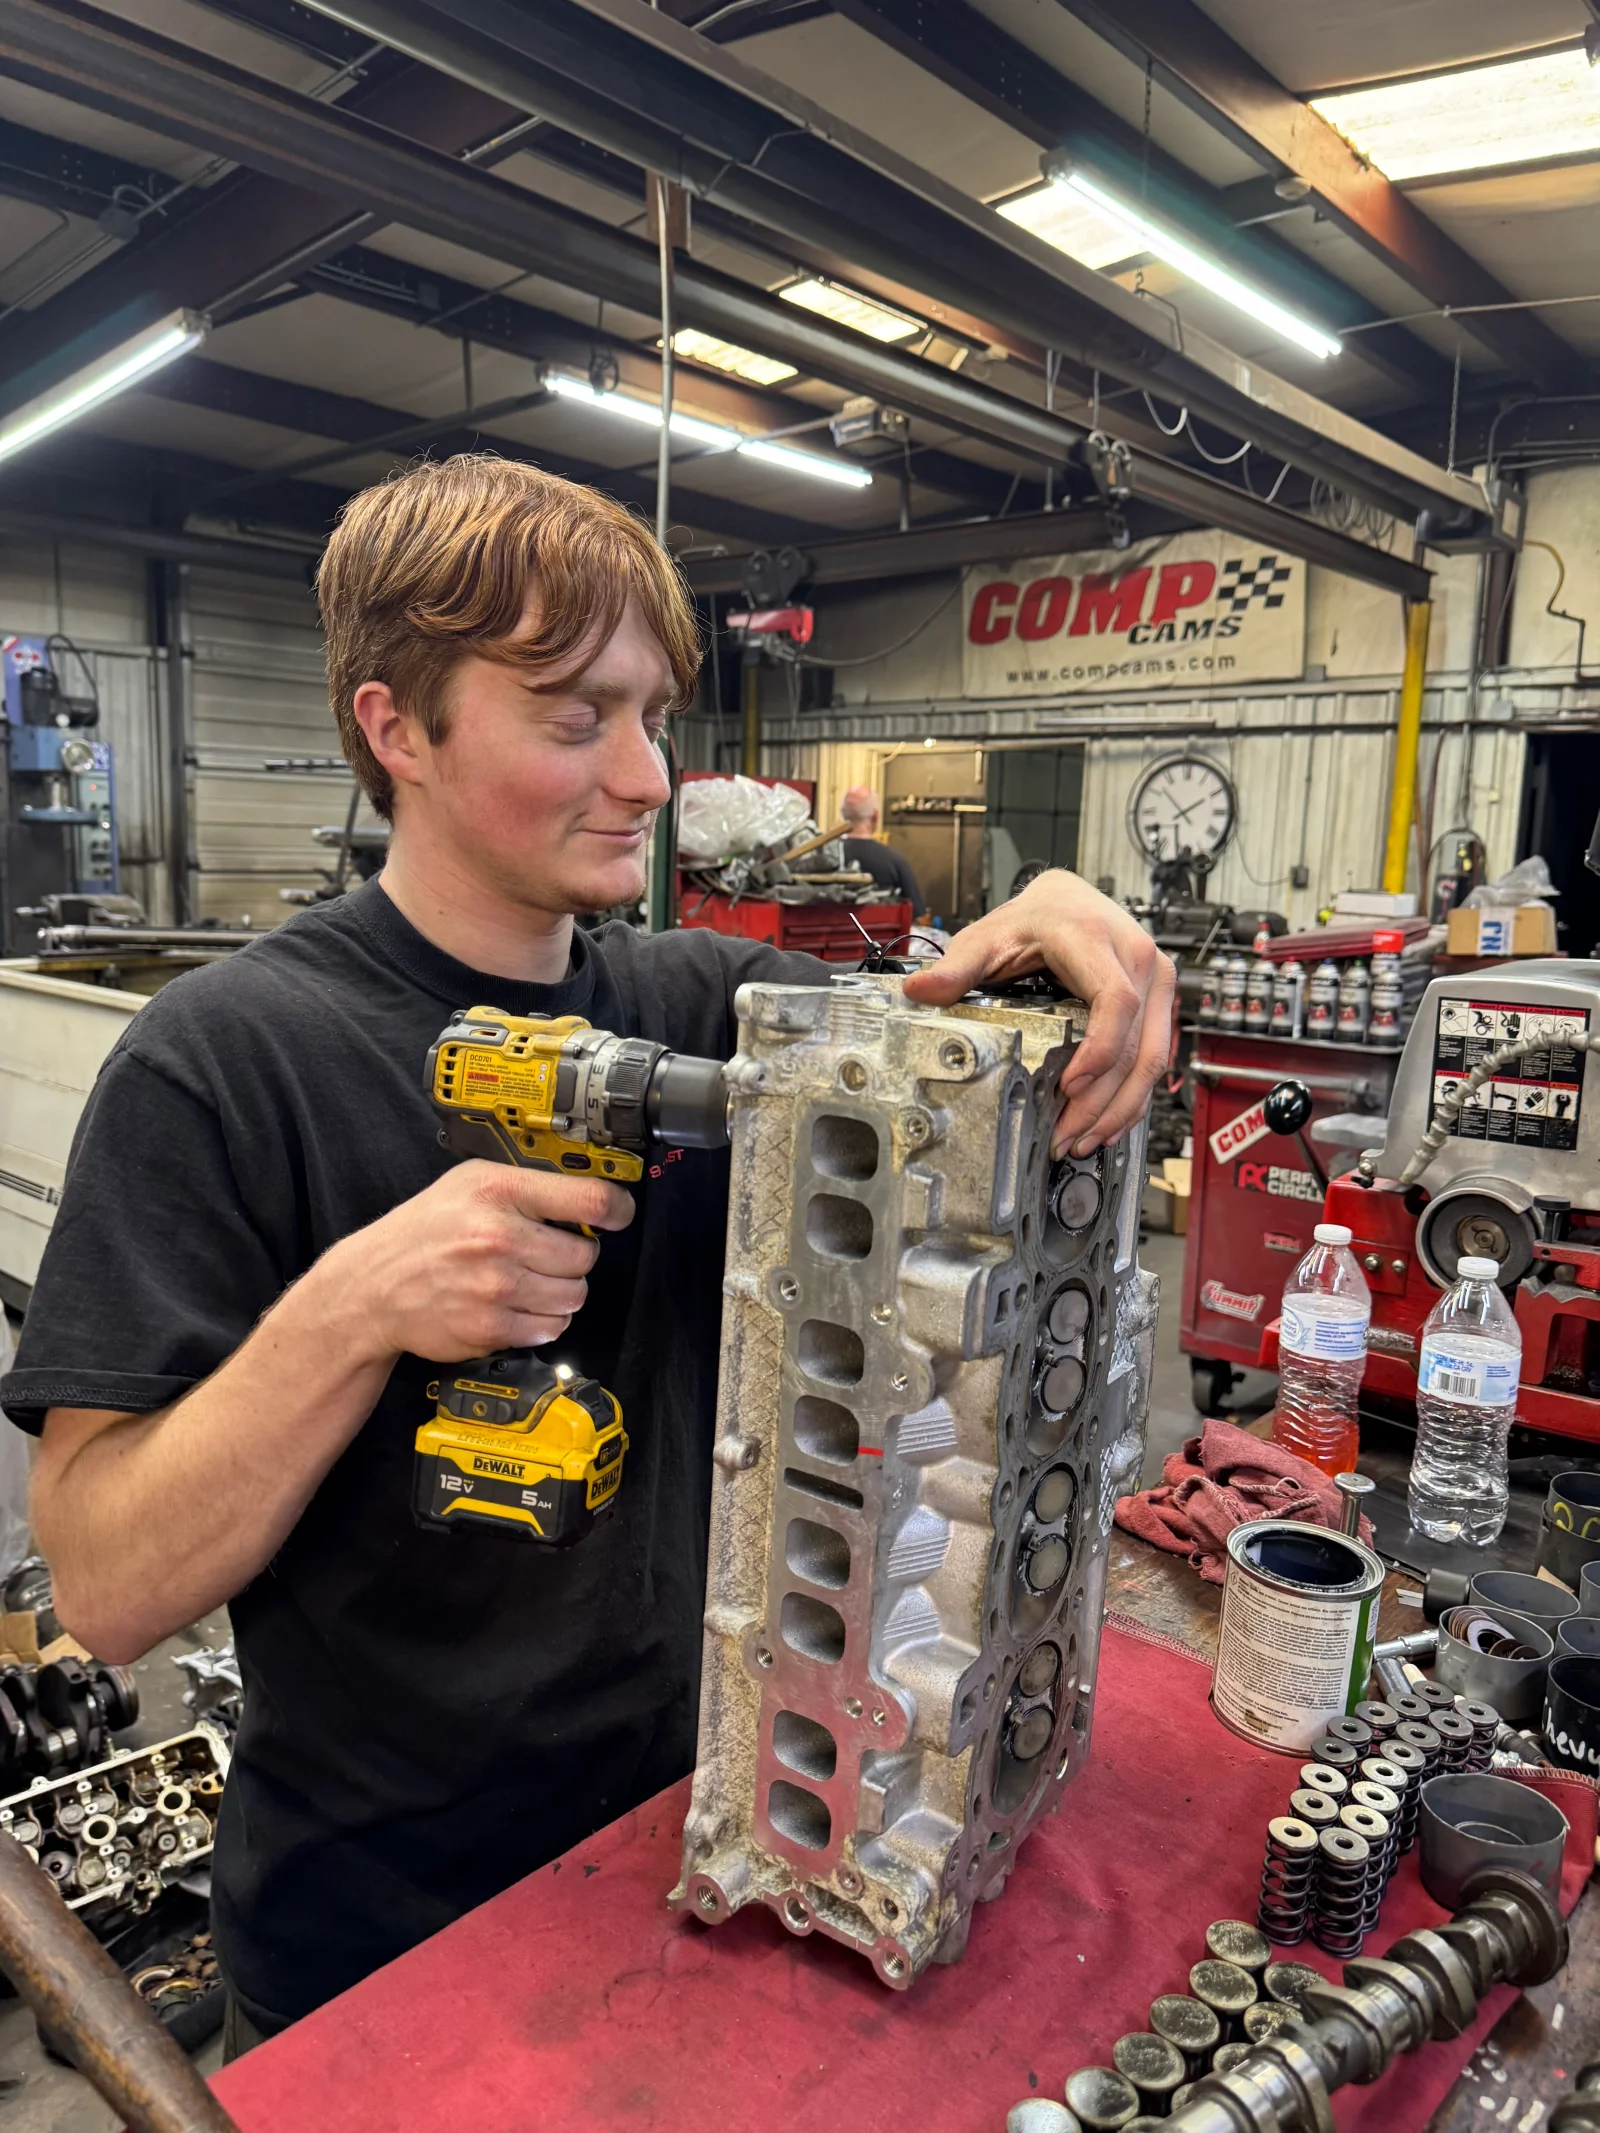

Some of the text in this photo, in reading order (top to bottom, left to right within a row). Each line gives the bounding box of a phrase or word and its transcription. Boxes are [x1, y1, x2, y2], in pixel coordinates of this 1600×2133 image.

[968, 560, 1216, 645] COMP
[1128, 615, 1244, 645] CAMS
[1006, 654, 1236, 684] www.compcams.com
[469, 1054, 492, 1064] DCD701
[1216, 1107, 1267, 1153] COM
[474, 1457, 526, 1478] DEWALT
